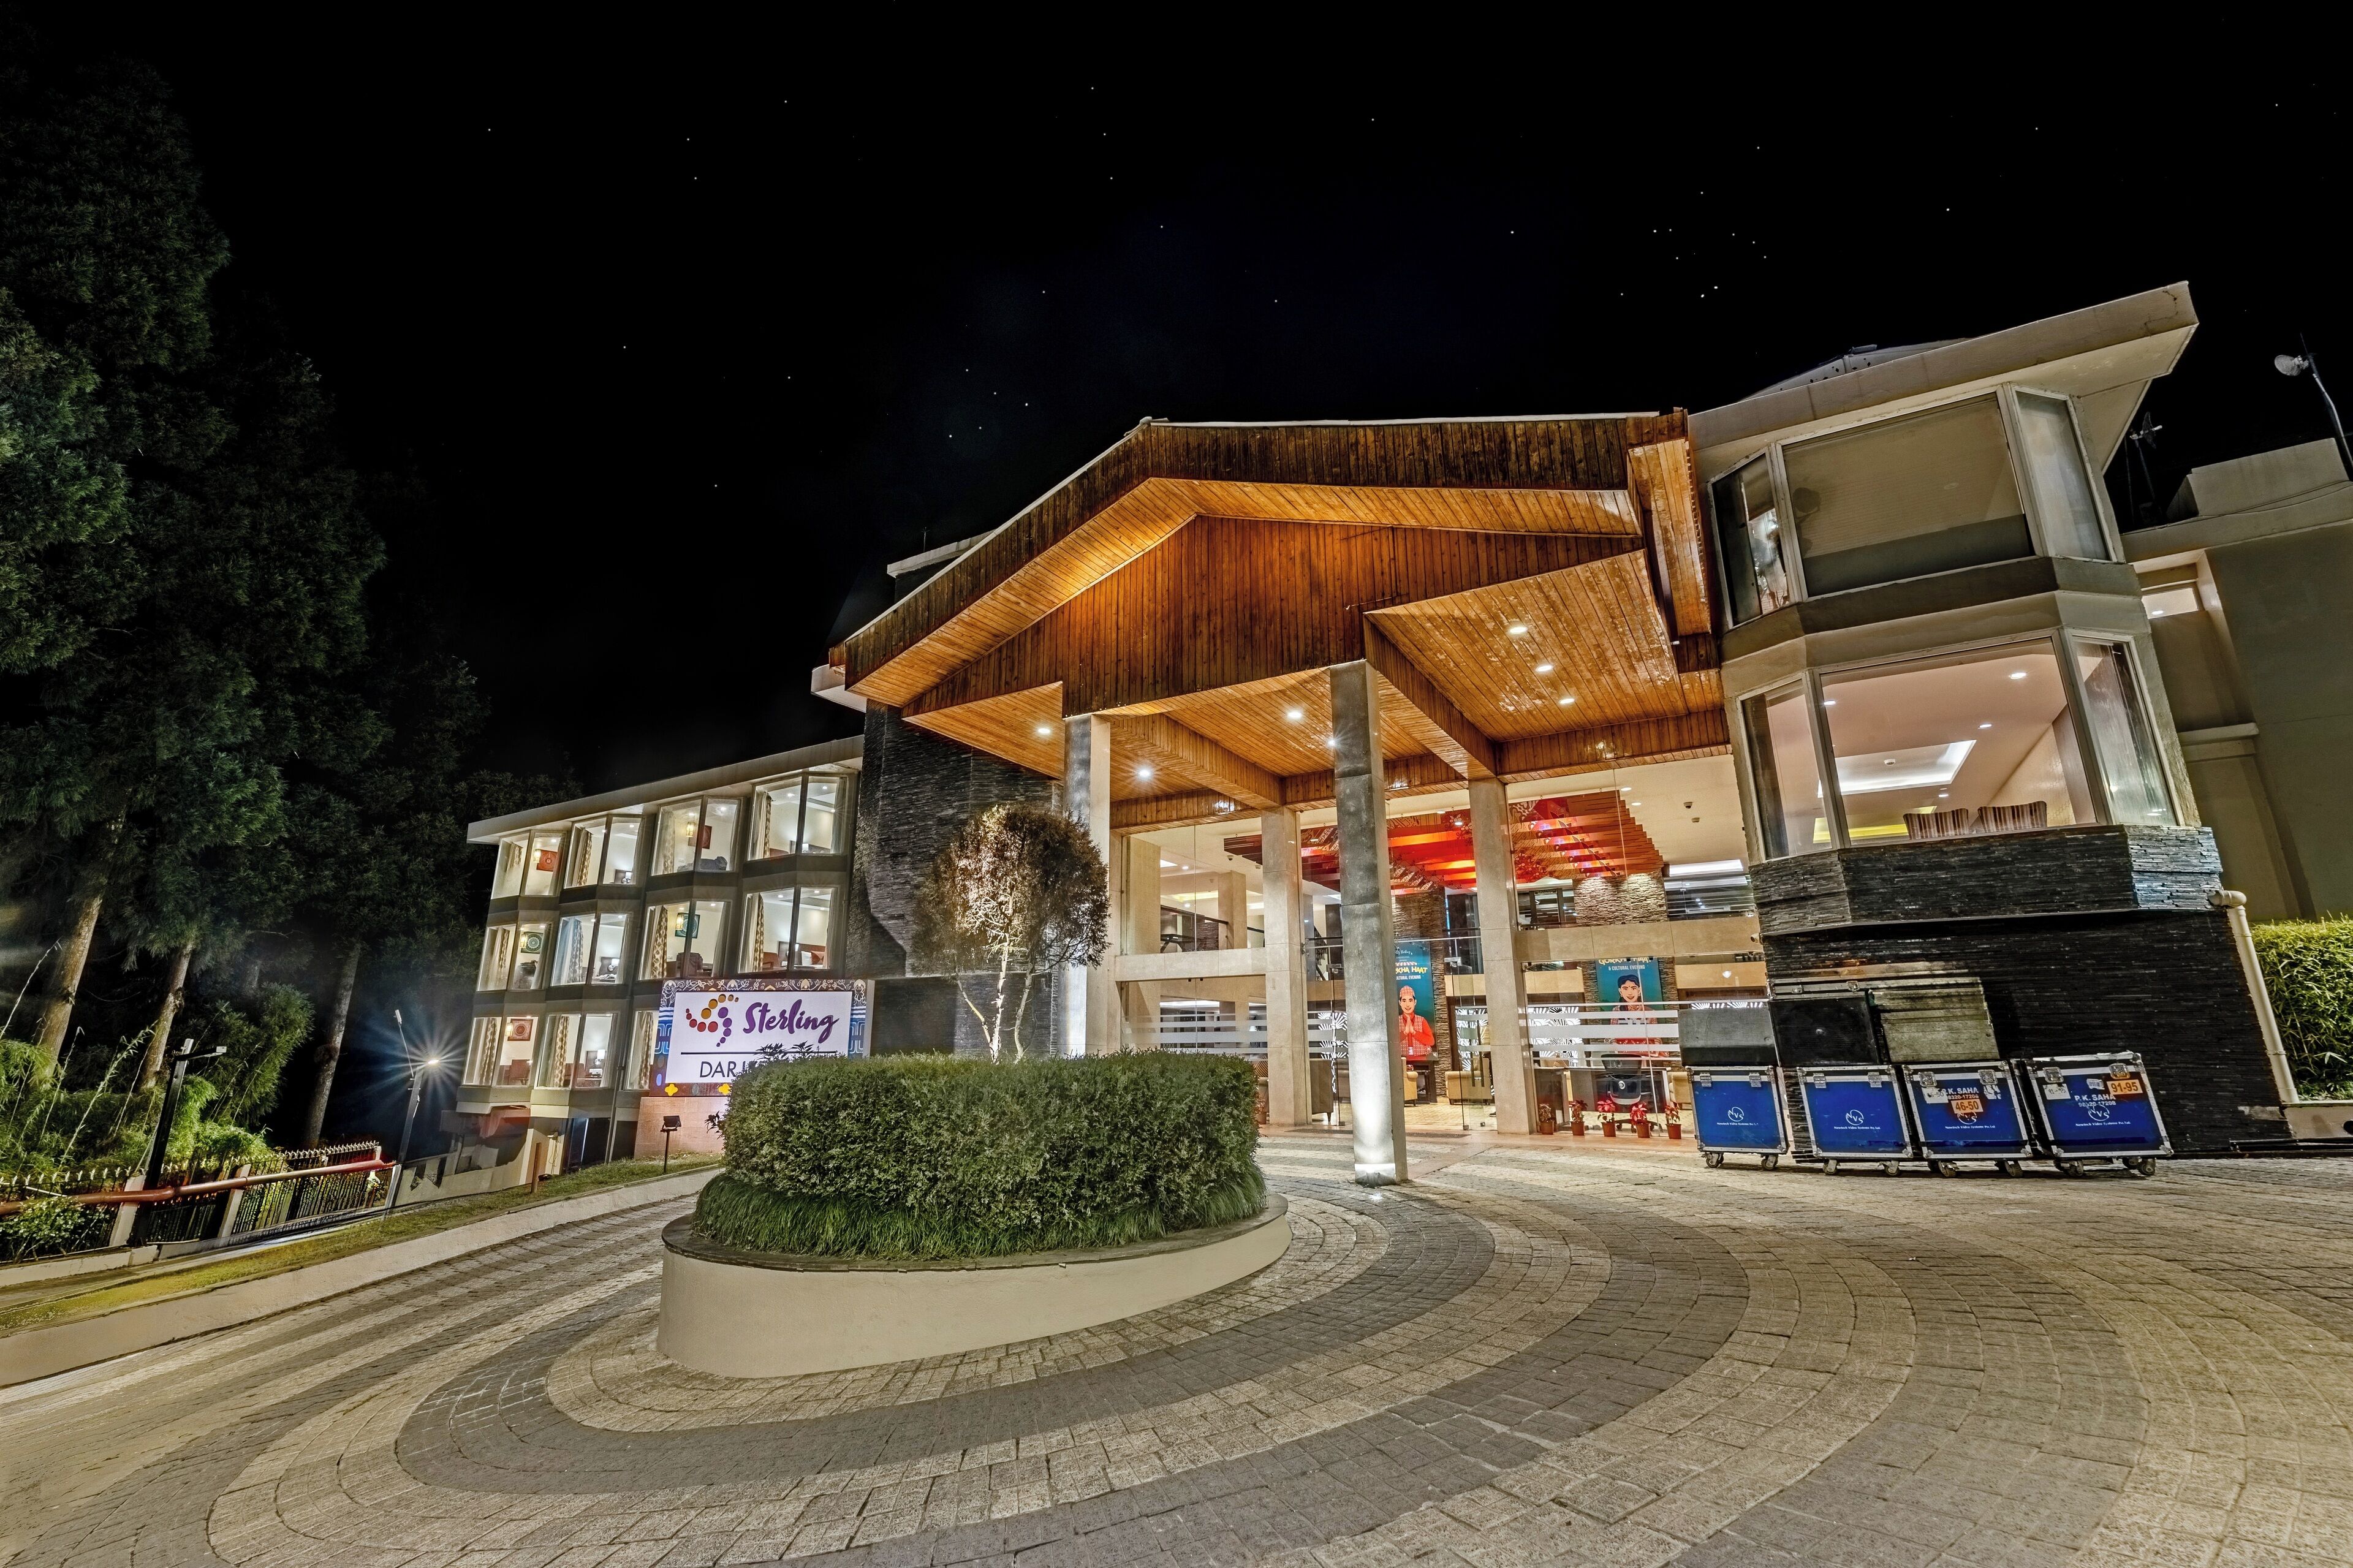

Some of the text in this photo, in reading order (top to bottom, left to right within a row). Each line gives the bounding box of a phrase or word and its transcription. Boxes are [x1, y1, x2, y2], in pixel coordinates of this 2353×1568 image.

[743, 999, 839, 1044] Sterling
[2111, 1081, 2139, 1093] 91-95
[1955, 1100, 1979, 1112] 46-50
[1727, 1107, 1744, 1122] NVS
[1846, 1109, 1864, 1126] NVS
